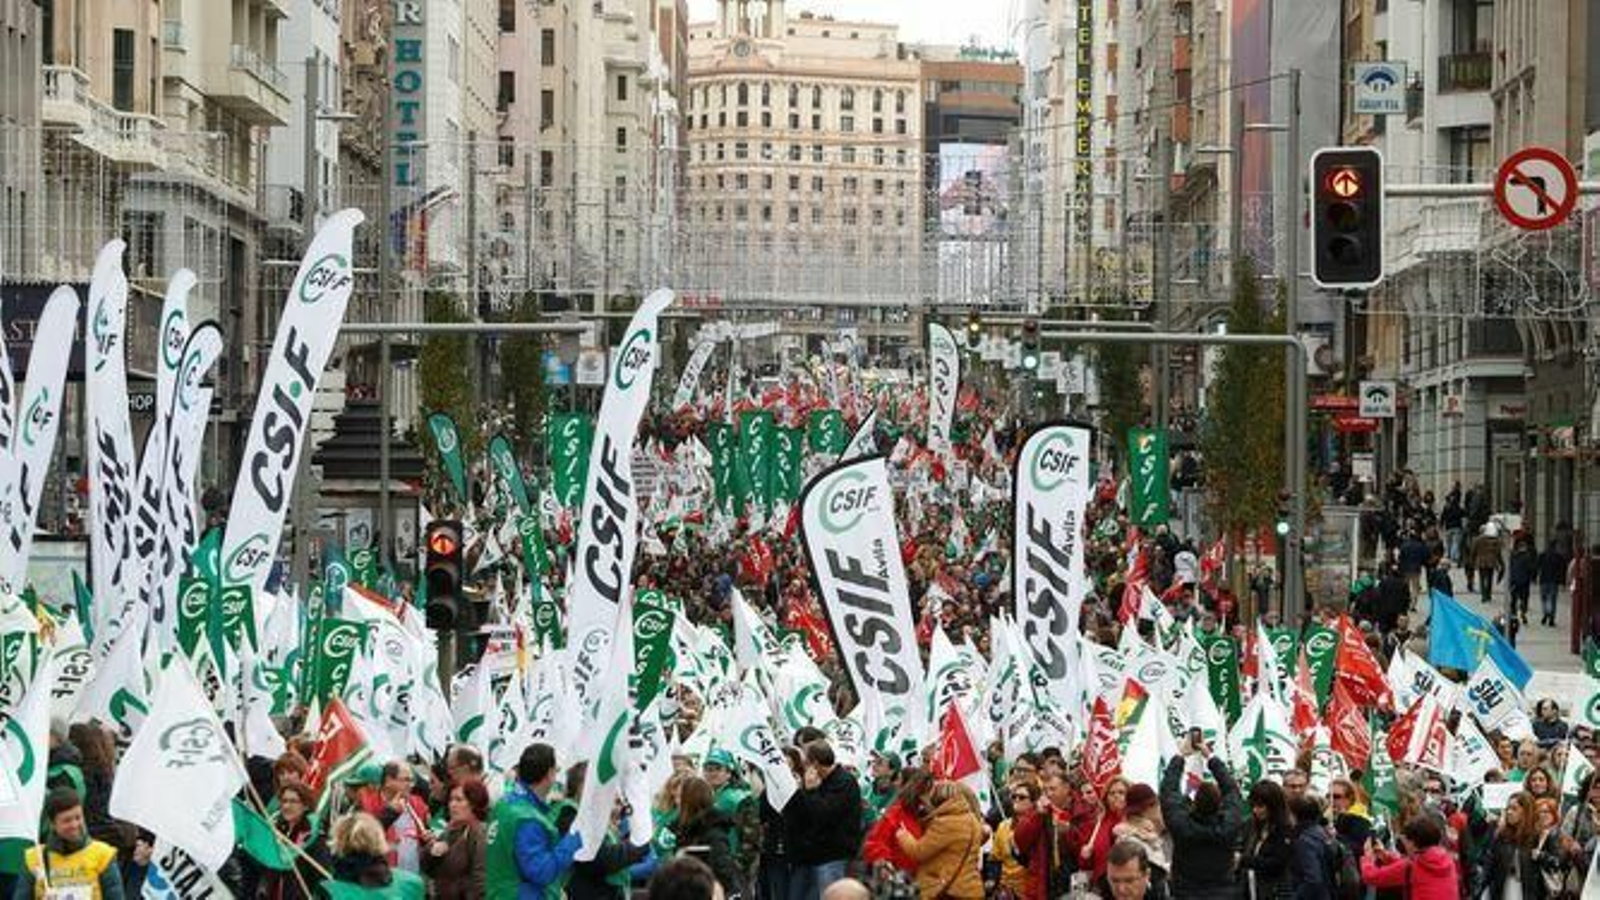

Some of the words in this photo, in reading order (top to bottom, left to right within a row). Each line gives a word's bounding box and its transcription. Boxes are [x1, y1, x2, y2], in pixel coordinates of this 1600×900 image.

[393, 39, 422, 187] HOTEL
[130, 395, 154, 411] HOP
[1039, 448, 1080, 475] CSIF
[585, 434, 630, 604] CSIF
[830, 485, 878, 514] CSIF
[824, 547, 910, 696] CSIF
[1023, 501, 1071, 680] CSIF
